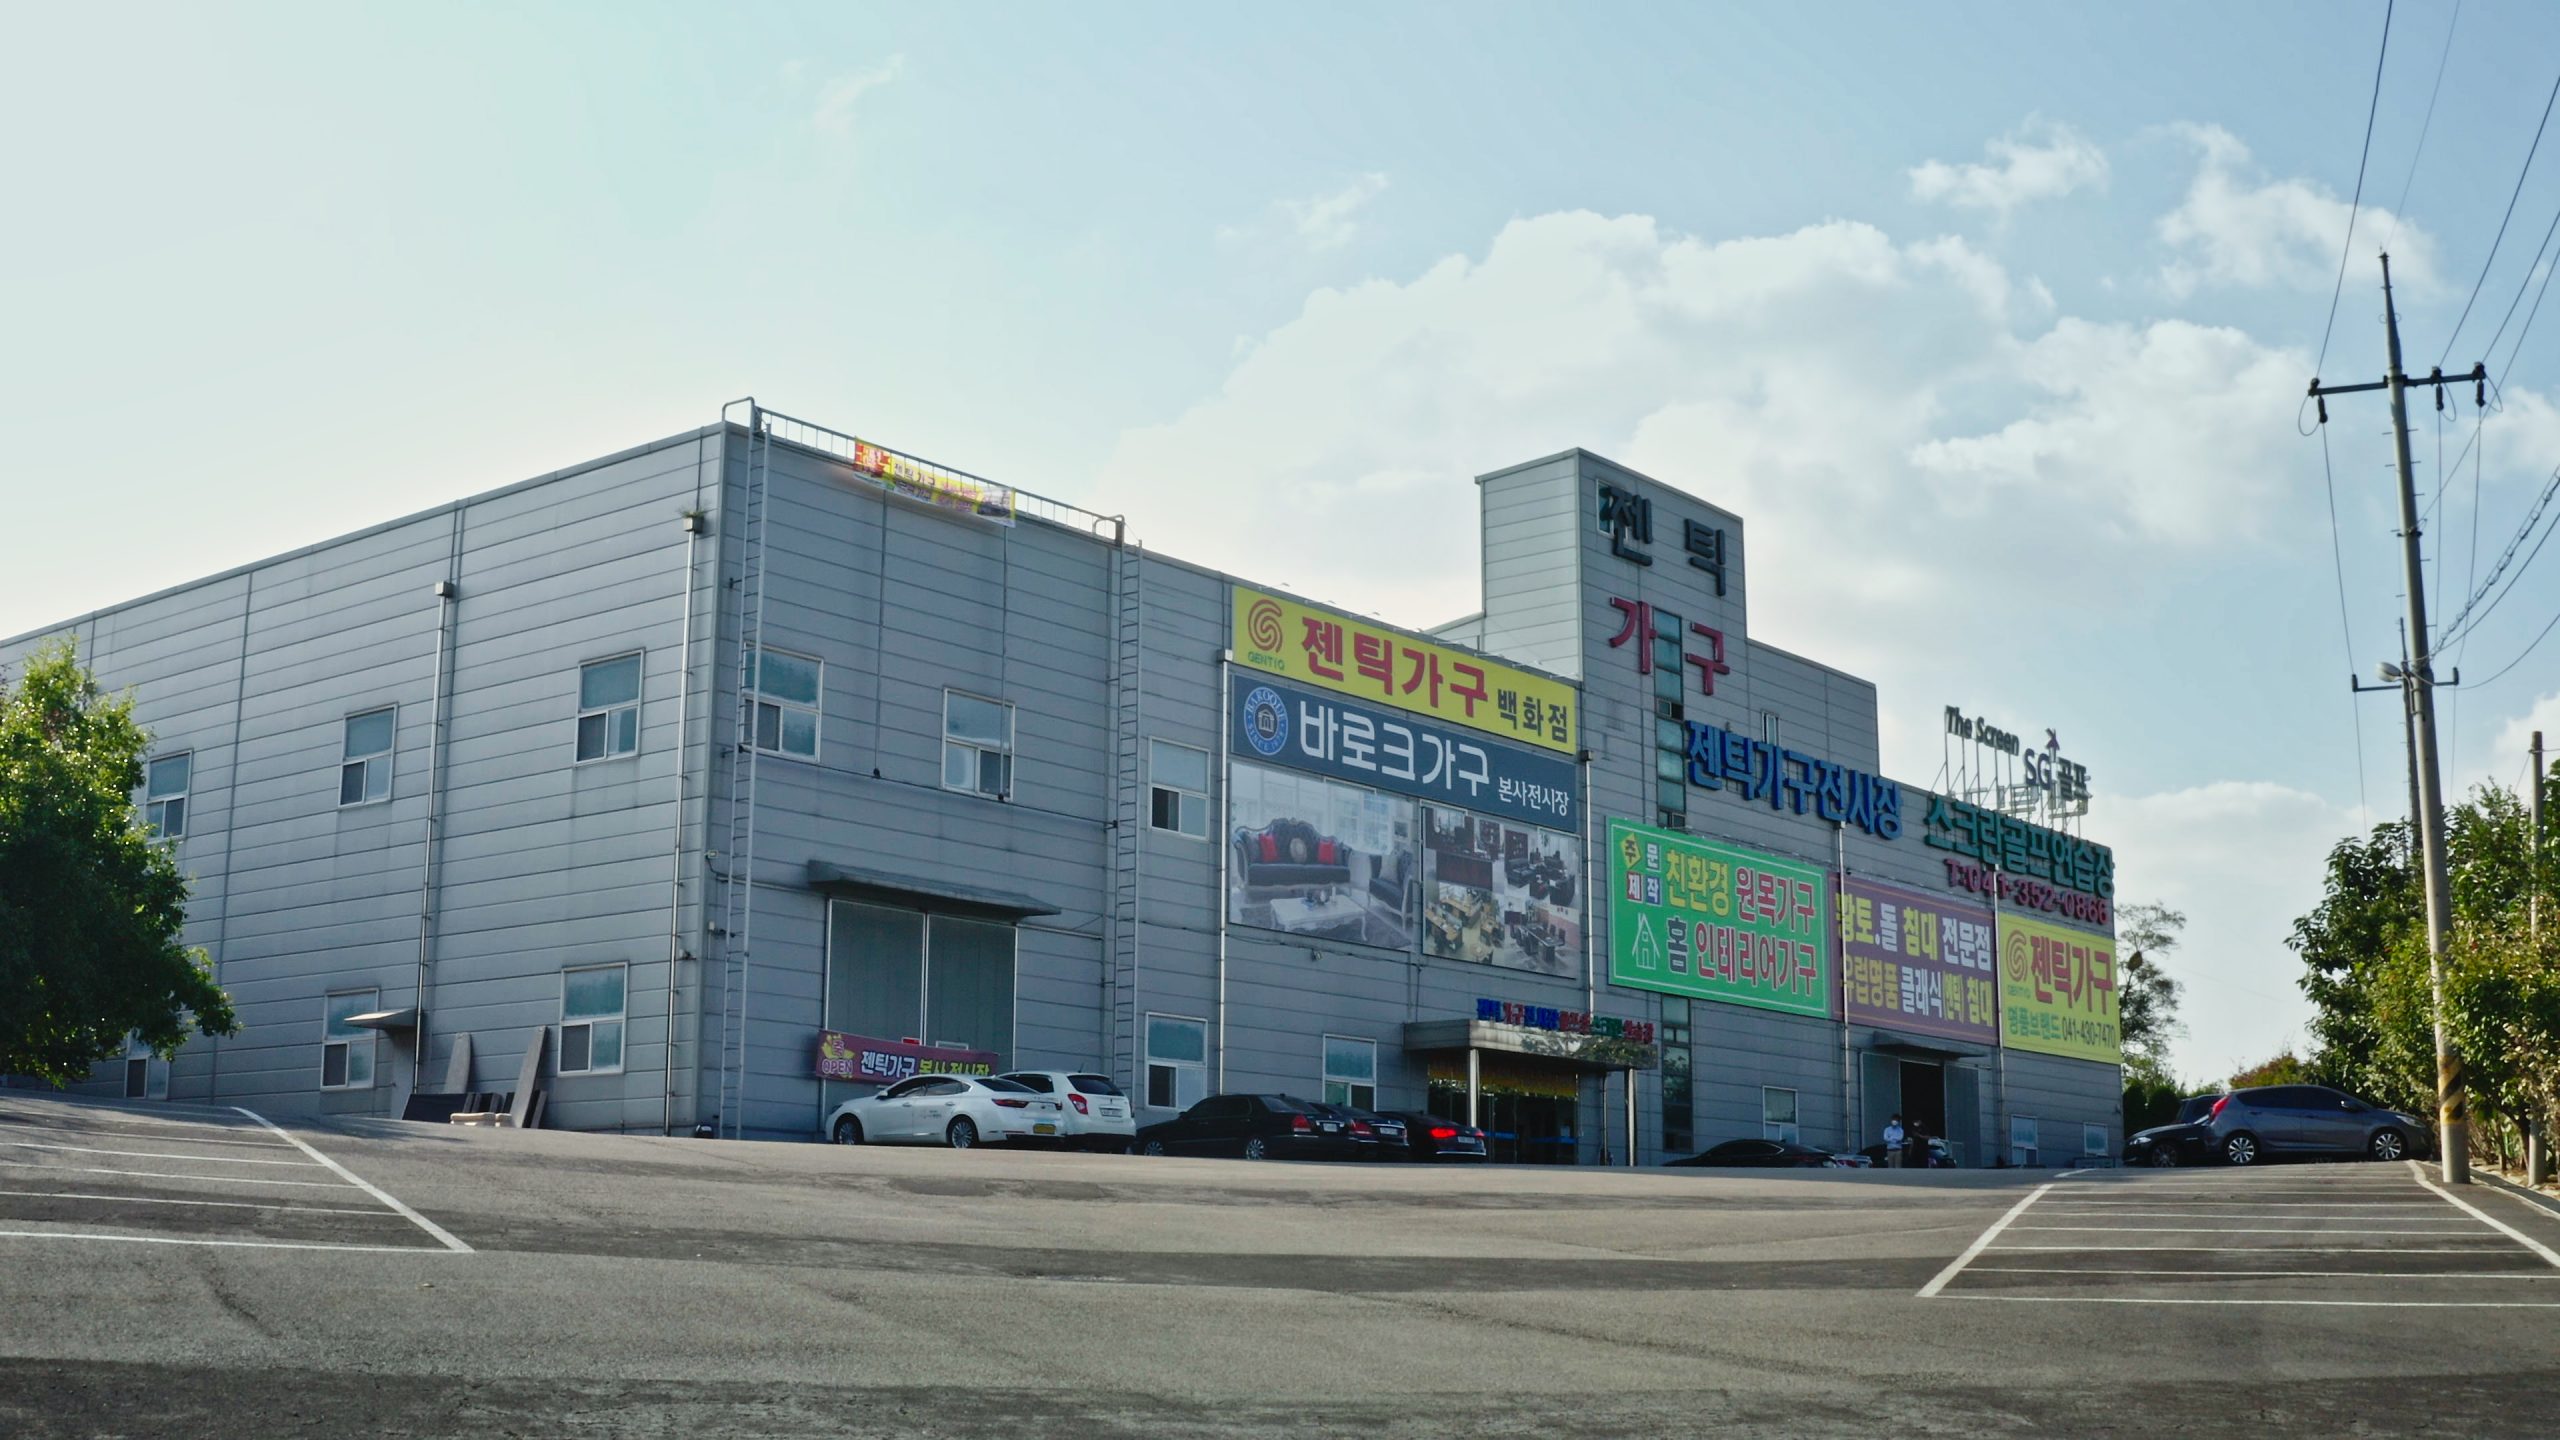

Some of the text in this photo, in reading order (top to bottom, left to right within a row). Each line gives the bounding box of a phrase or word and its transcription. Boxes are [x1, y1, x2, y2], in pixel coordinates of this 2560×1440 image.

[1603, 485, 1727, 597] 젠틱
[1302, 615, 1568, 744] 젠틱가구 백화점
[1608, 595, 1731, 696] 가구
[1299, 700, 1570, 817] 바로크가구 본사전시장
[1945, 704, 2020, 756] The Screen
[1685, 719, 1904, 842] 젠틱가구전시장
[1923, 793, 2115, 898] 스크린골프연습장
[1626, 871, 1661, 906] 제작
[1666, 849, 1731, 917] 친환경
[1736, 866, 1816, 934] 원목가구
[1667, 914, 1818, 996] 홈 인테리어가구
[1903, 907, 1938, 961] 침대
[1942, 916, 1992, 972] 전문점
[2030, 935, 2114, 1016] 젠틱가구
[1967, 976, 1993, 1028] 침대
[822, 1058, 853, 1075] OPEN
[861, 1051, 916, 1077] 젠틱가구
